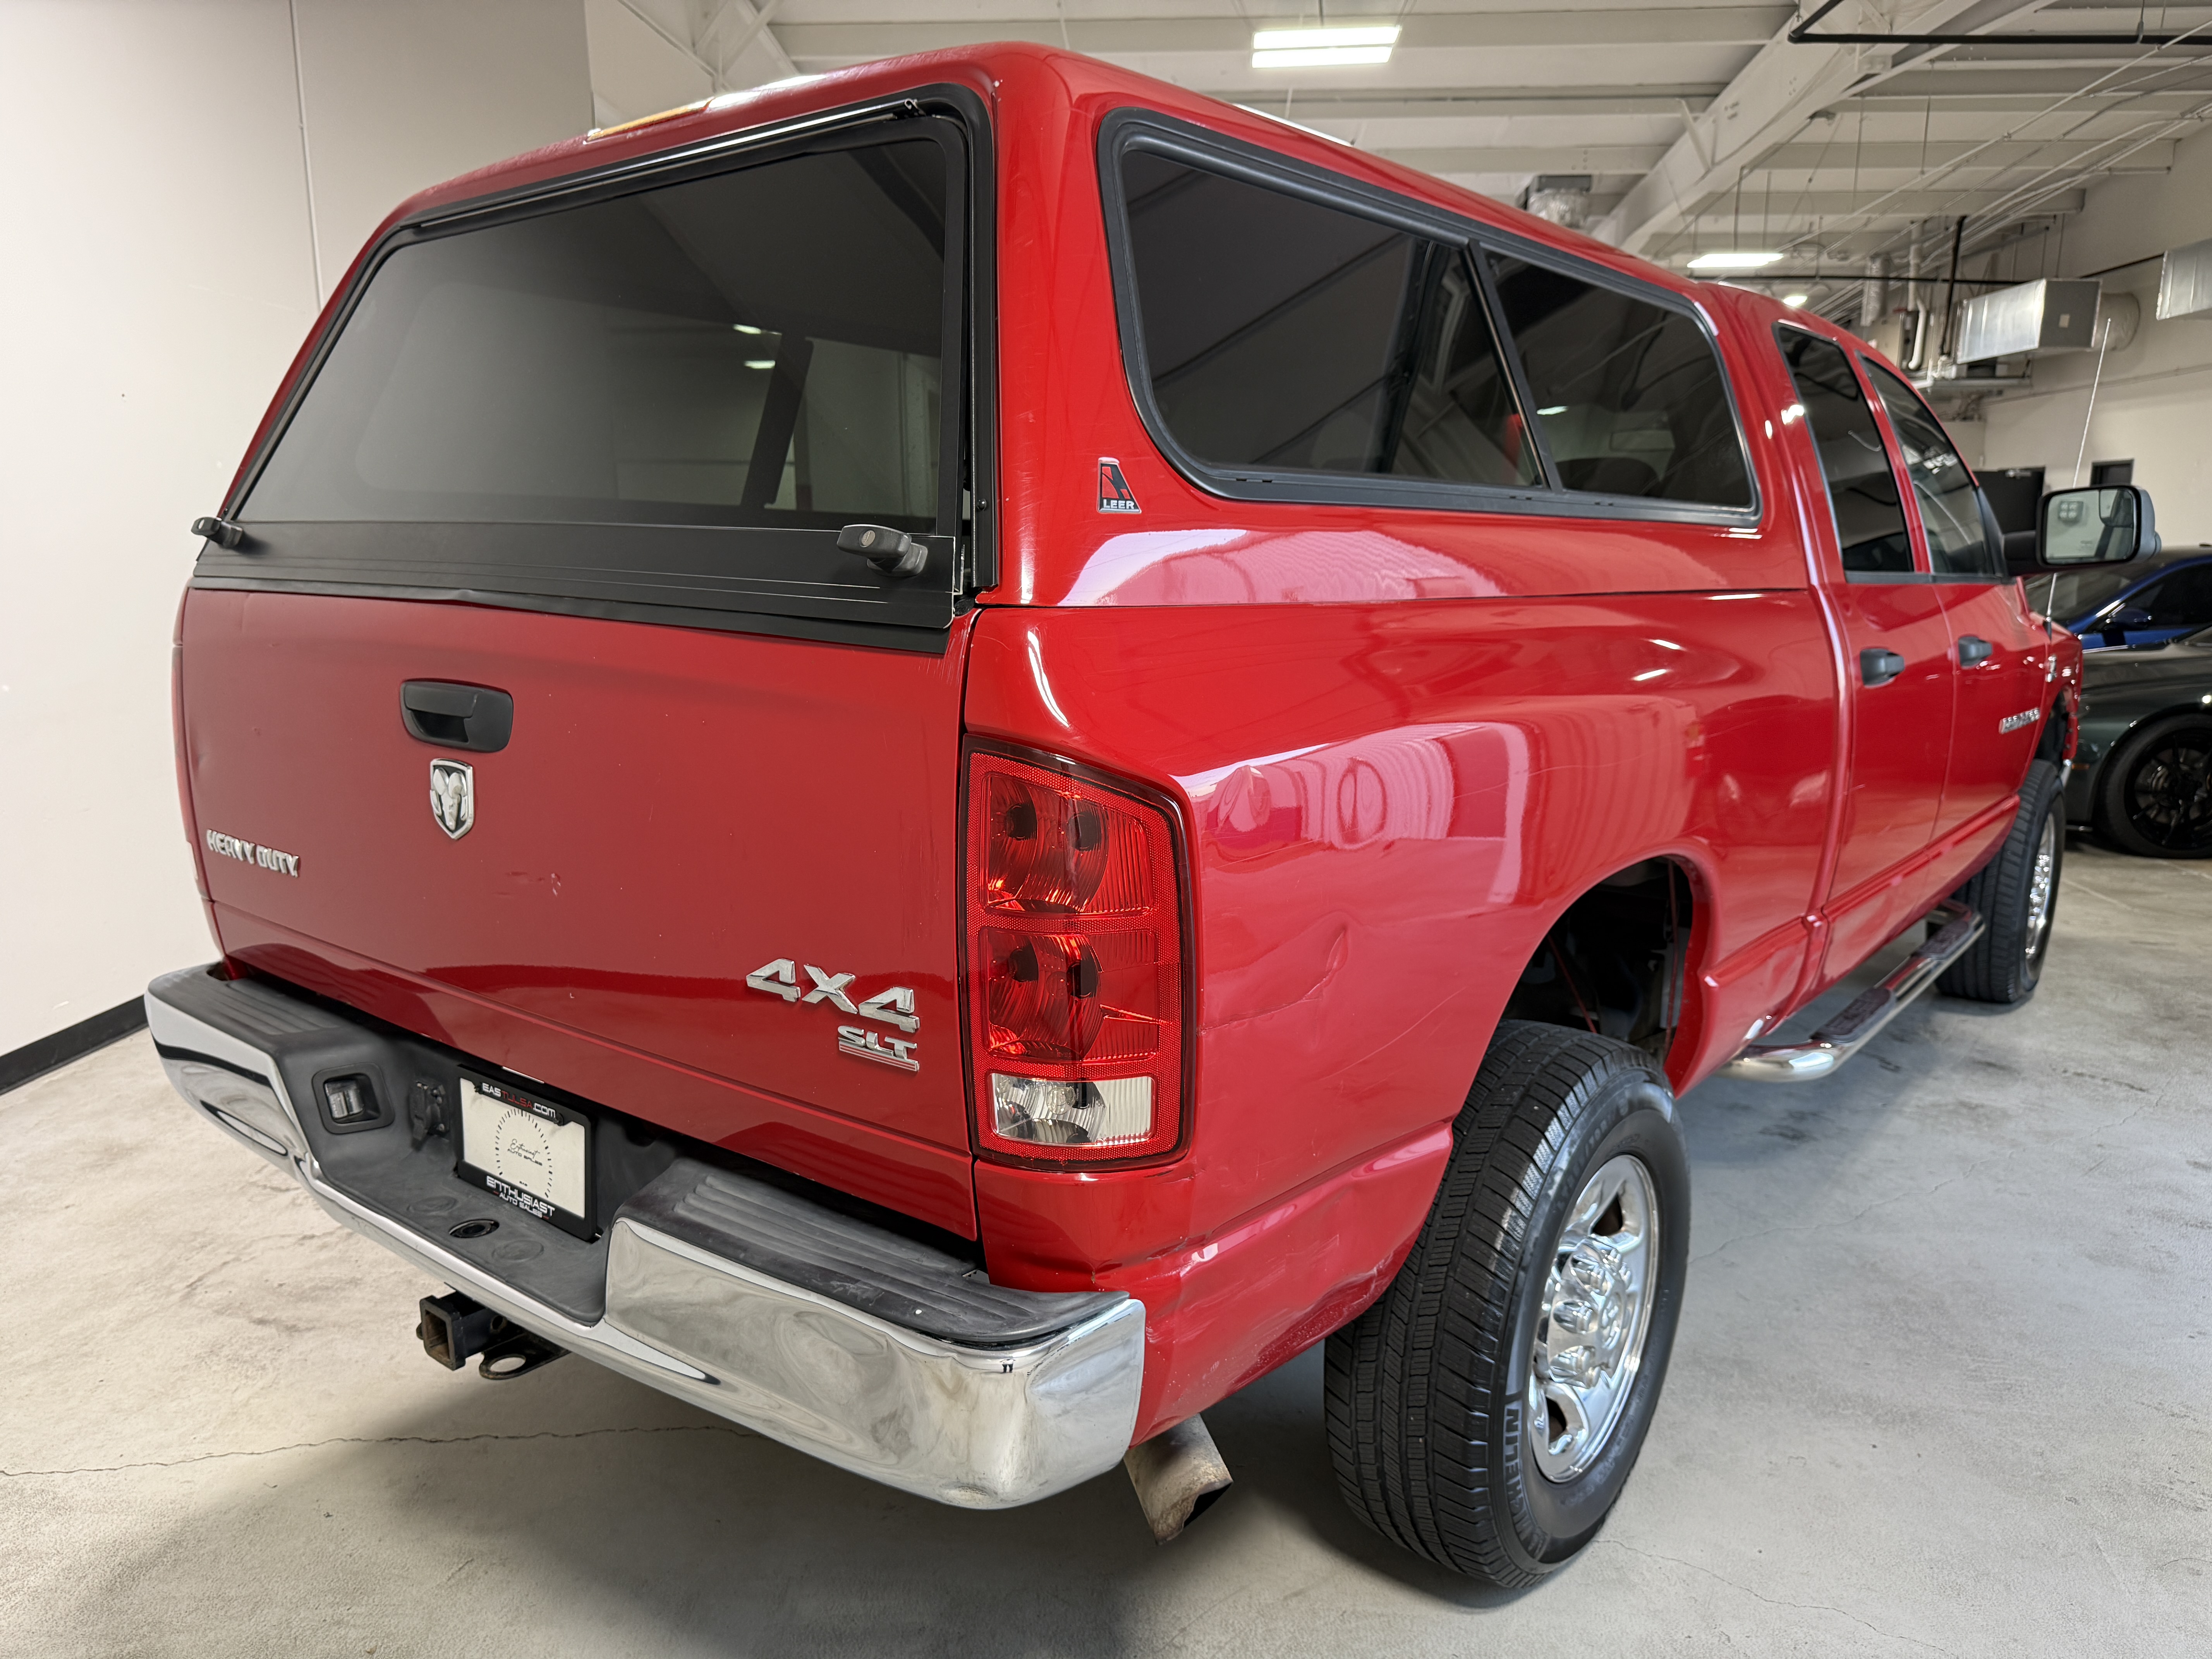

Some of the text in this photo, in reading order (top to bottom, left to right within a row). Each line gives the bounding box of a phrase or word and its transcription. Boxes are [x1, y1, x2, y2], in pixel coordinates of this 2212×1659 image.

[1103, 499, 1134, 510] LEER
[206, 829, 299, 878] HEAVY DUTY
[746, 958, 920, 1033] 4X4
[838, 1025, 918, 1060] SLT
[486, 1175, 555, 1216] ENTHUSIAST
[499, 1192, 543, 1219] AUTO SALES
